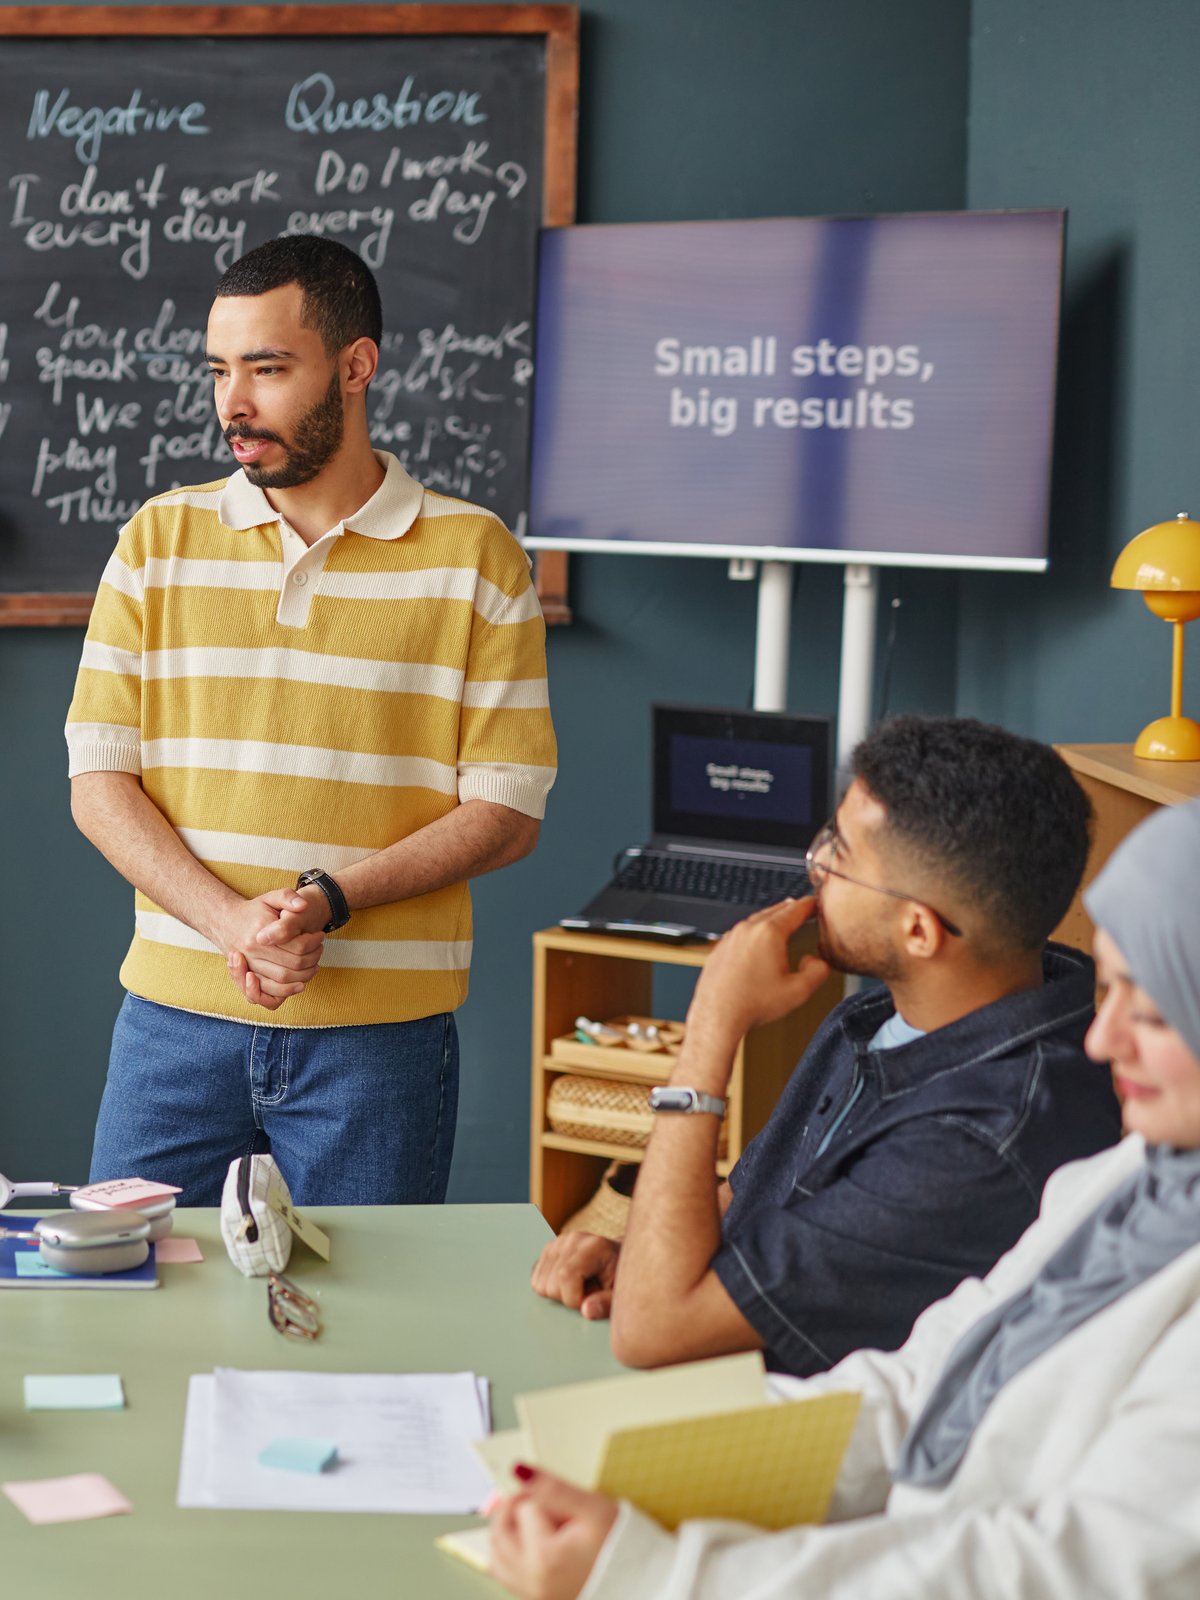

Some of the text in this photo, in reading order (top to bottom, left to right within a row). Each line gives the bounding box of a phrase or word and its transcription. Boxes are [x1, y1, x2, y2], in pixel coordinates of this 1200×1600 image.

[27, 88, 210, 164] Negative
[284, 72, 486, 134] Question
[8, 173, 41, 228] I
[59, 164, 168, 218] don't
[315, 149, 369, 196] Do
[25, 205, 246, 279] every day
[278, 206, 394, 270] every
[654, 336, 936, 384] Small steps,
[76, 392, 142, 436] We
[669, 387, 915, 437] big results
